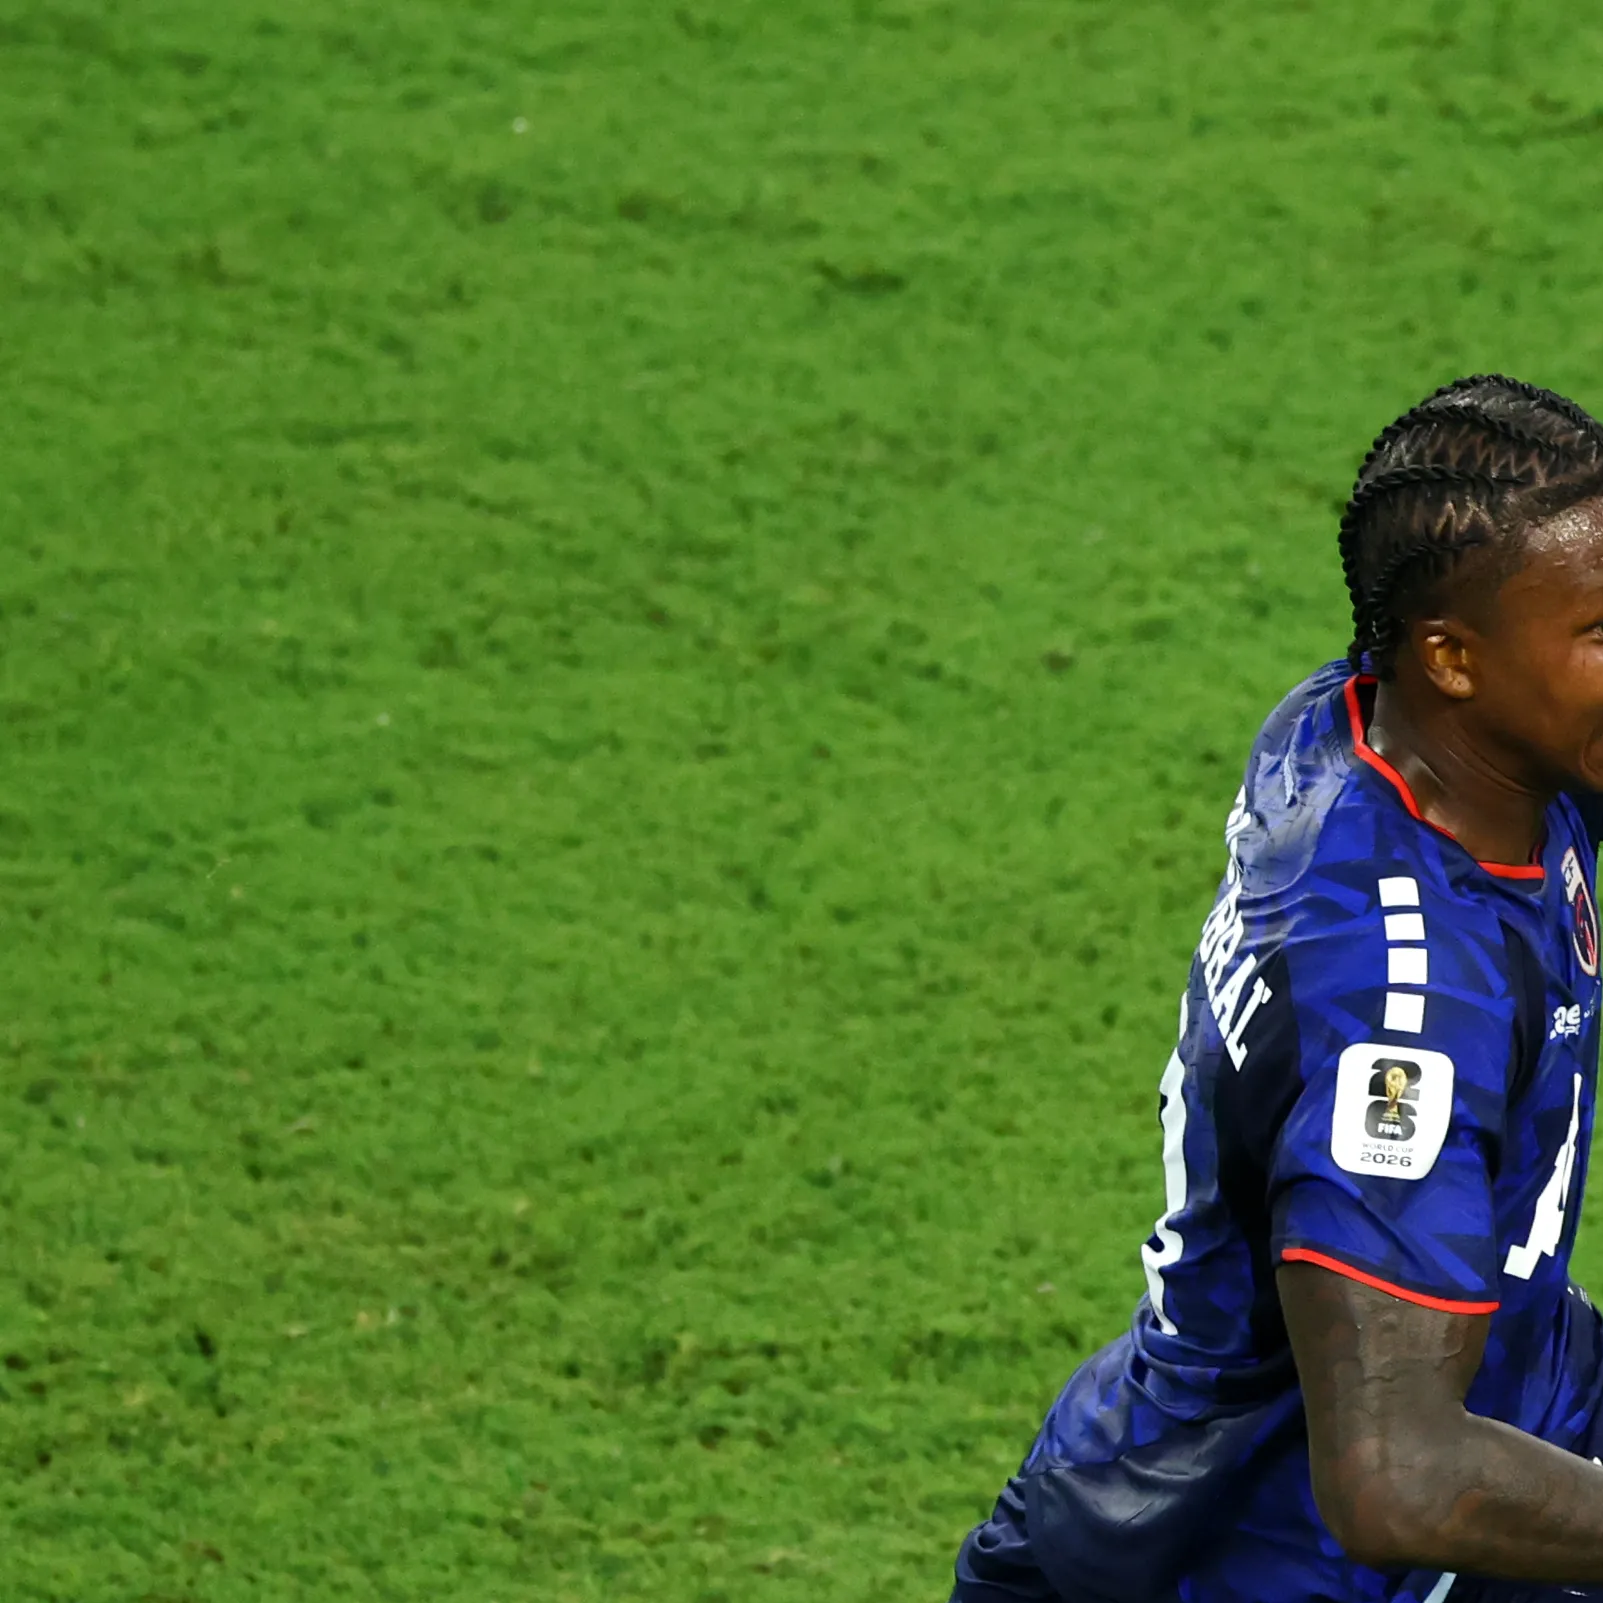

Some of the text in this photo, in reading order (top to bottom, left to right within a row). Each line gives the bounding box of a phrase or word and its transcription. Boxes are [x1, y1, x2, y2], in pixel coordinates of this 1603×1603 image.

[1377, 1122, 1403, 1136] FIFA
[1361, 1142, 1414, 1154] WORLD CUP
[1359, 1151, 1413, 1168] 2026
